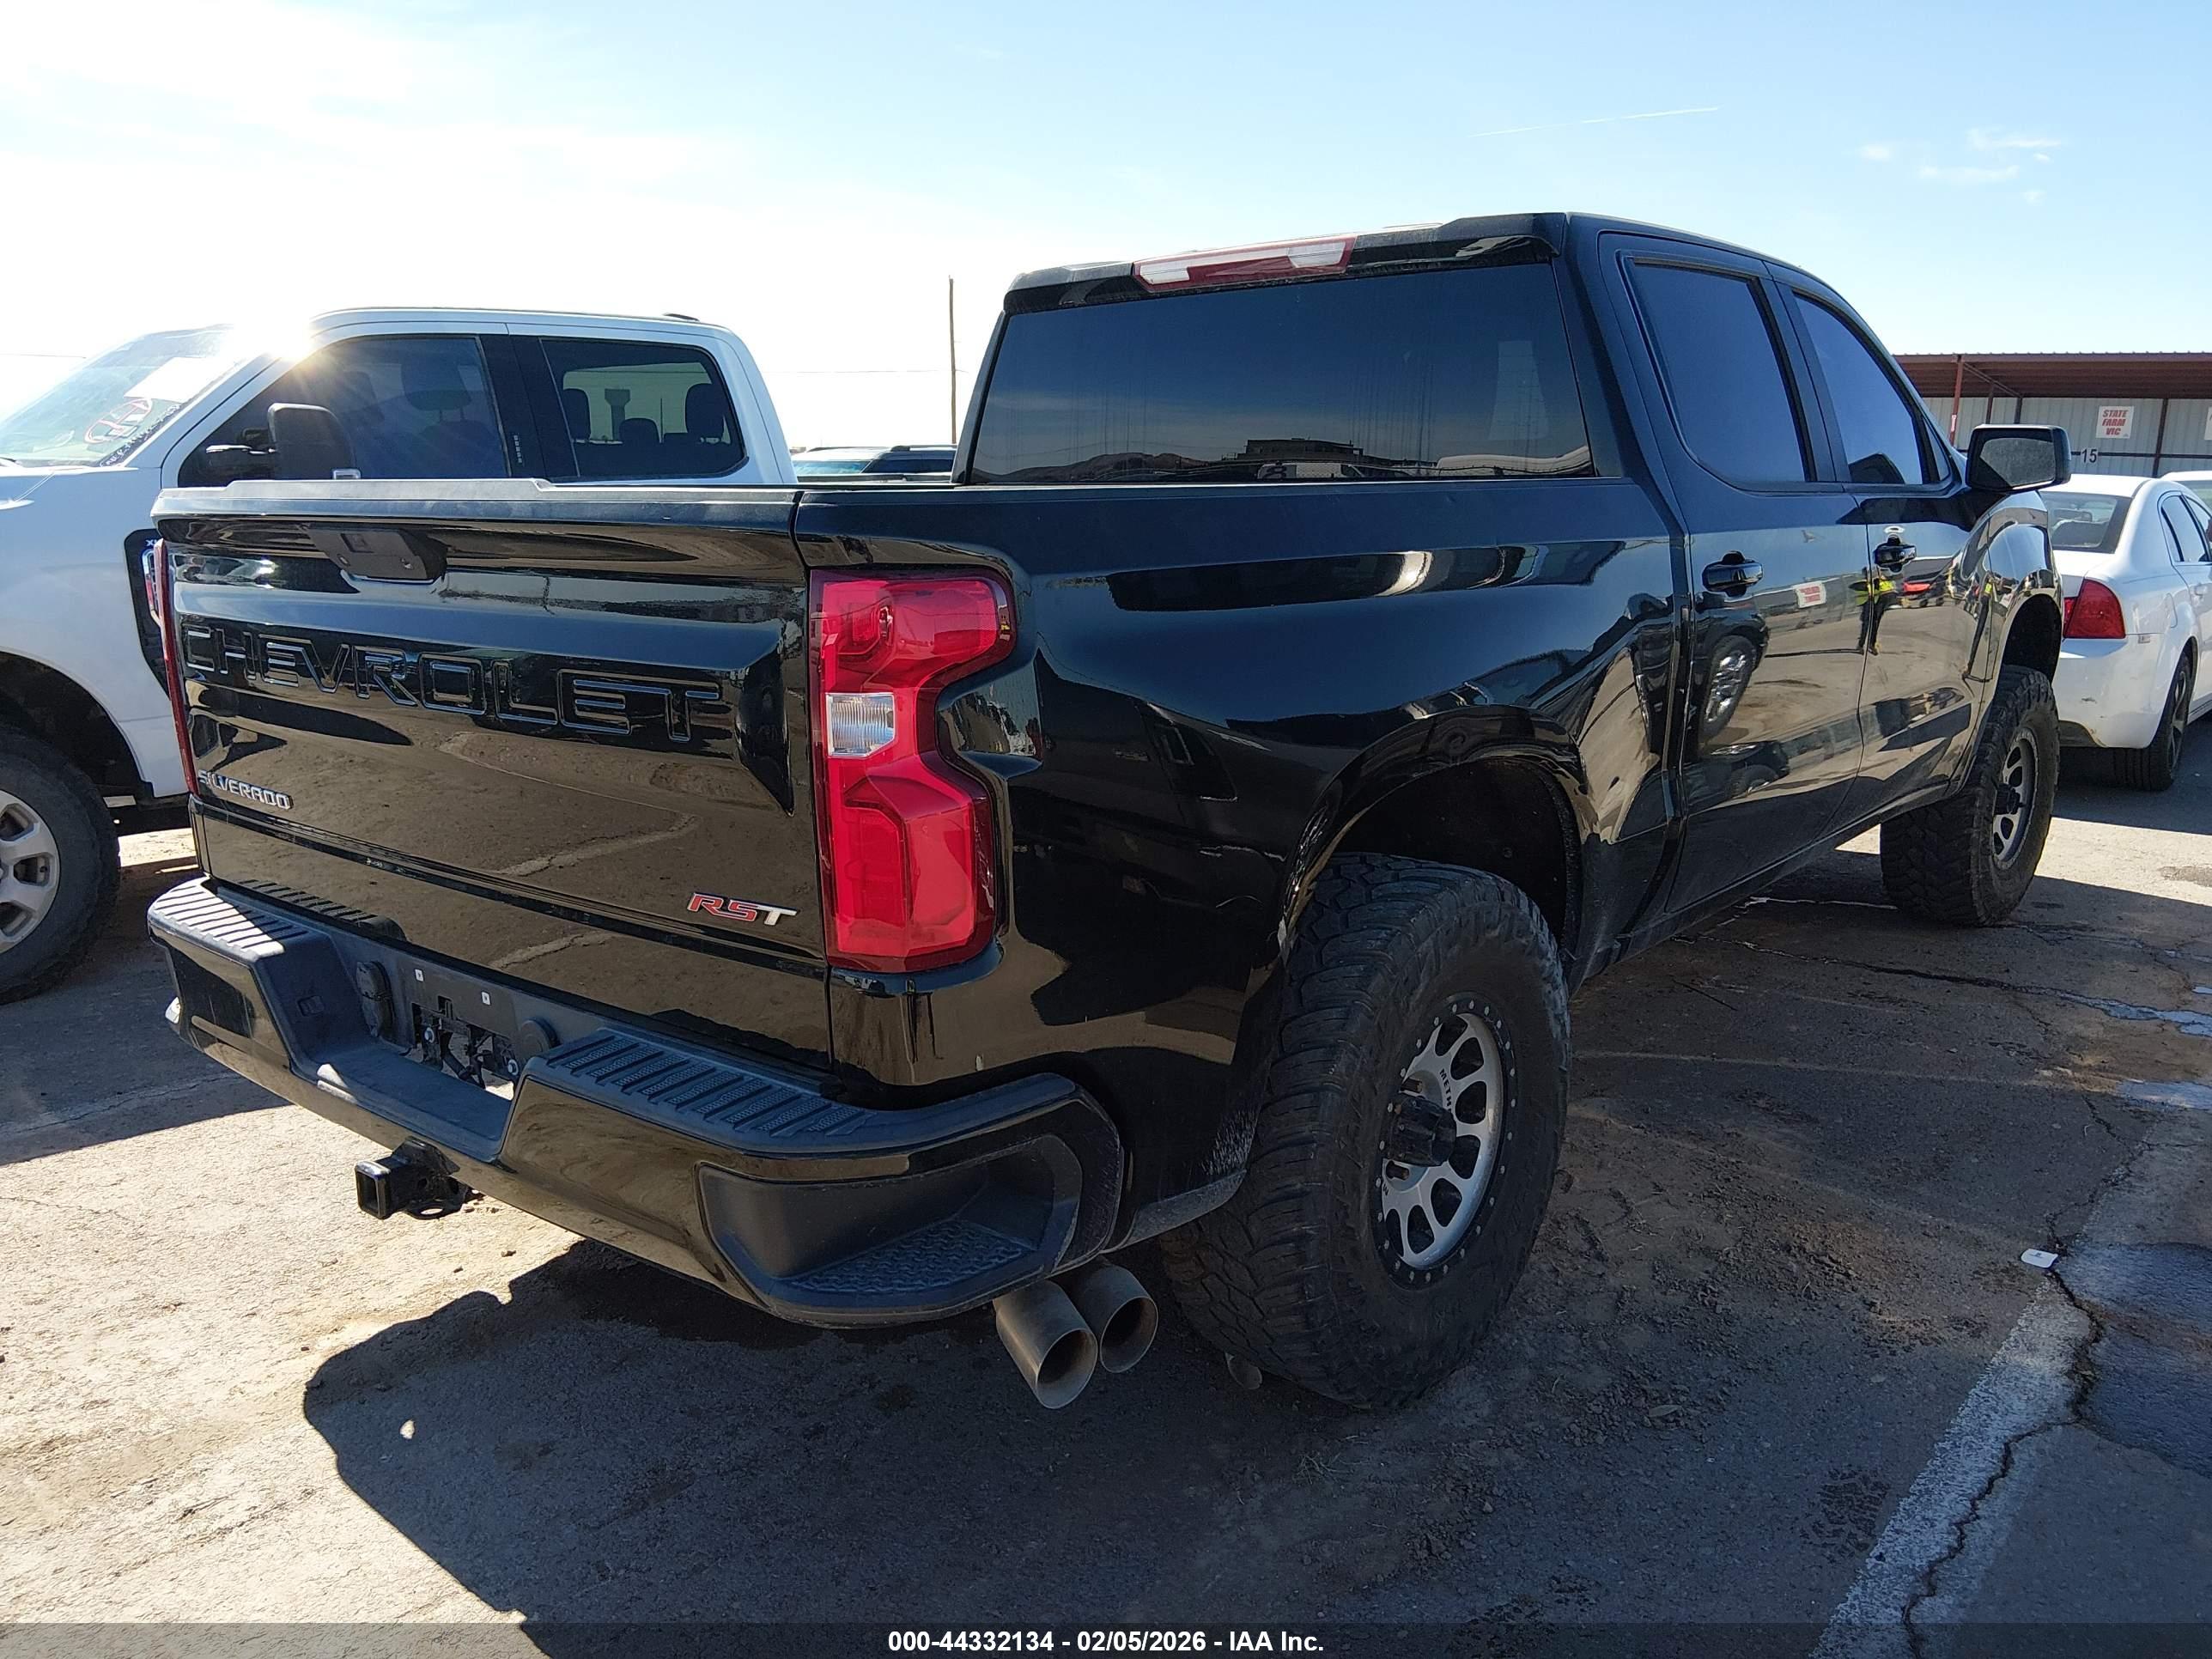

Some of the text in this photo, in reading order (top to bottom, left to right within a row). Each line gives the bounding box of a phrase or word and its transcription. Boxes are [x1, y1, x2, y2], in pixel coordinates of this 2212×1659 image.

[2081, 448, 2098, 463] 15
[181, 623, 720, 743] CHEVROLET
[198, 769, 294, 809] SILVERADO
[687, 891, 800, 926] RST
